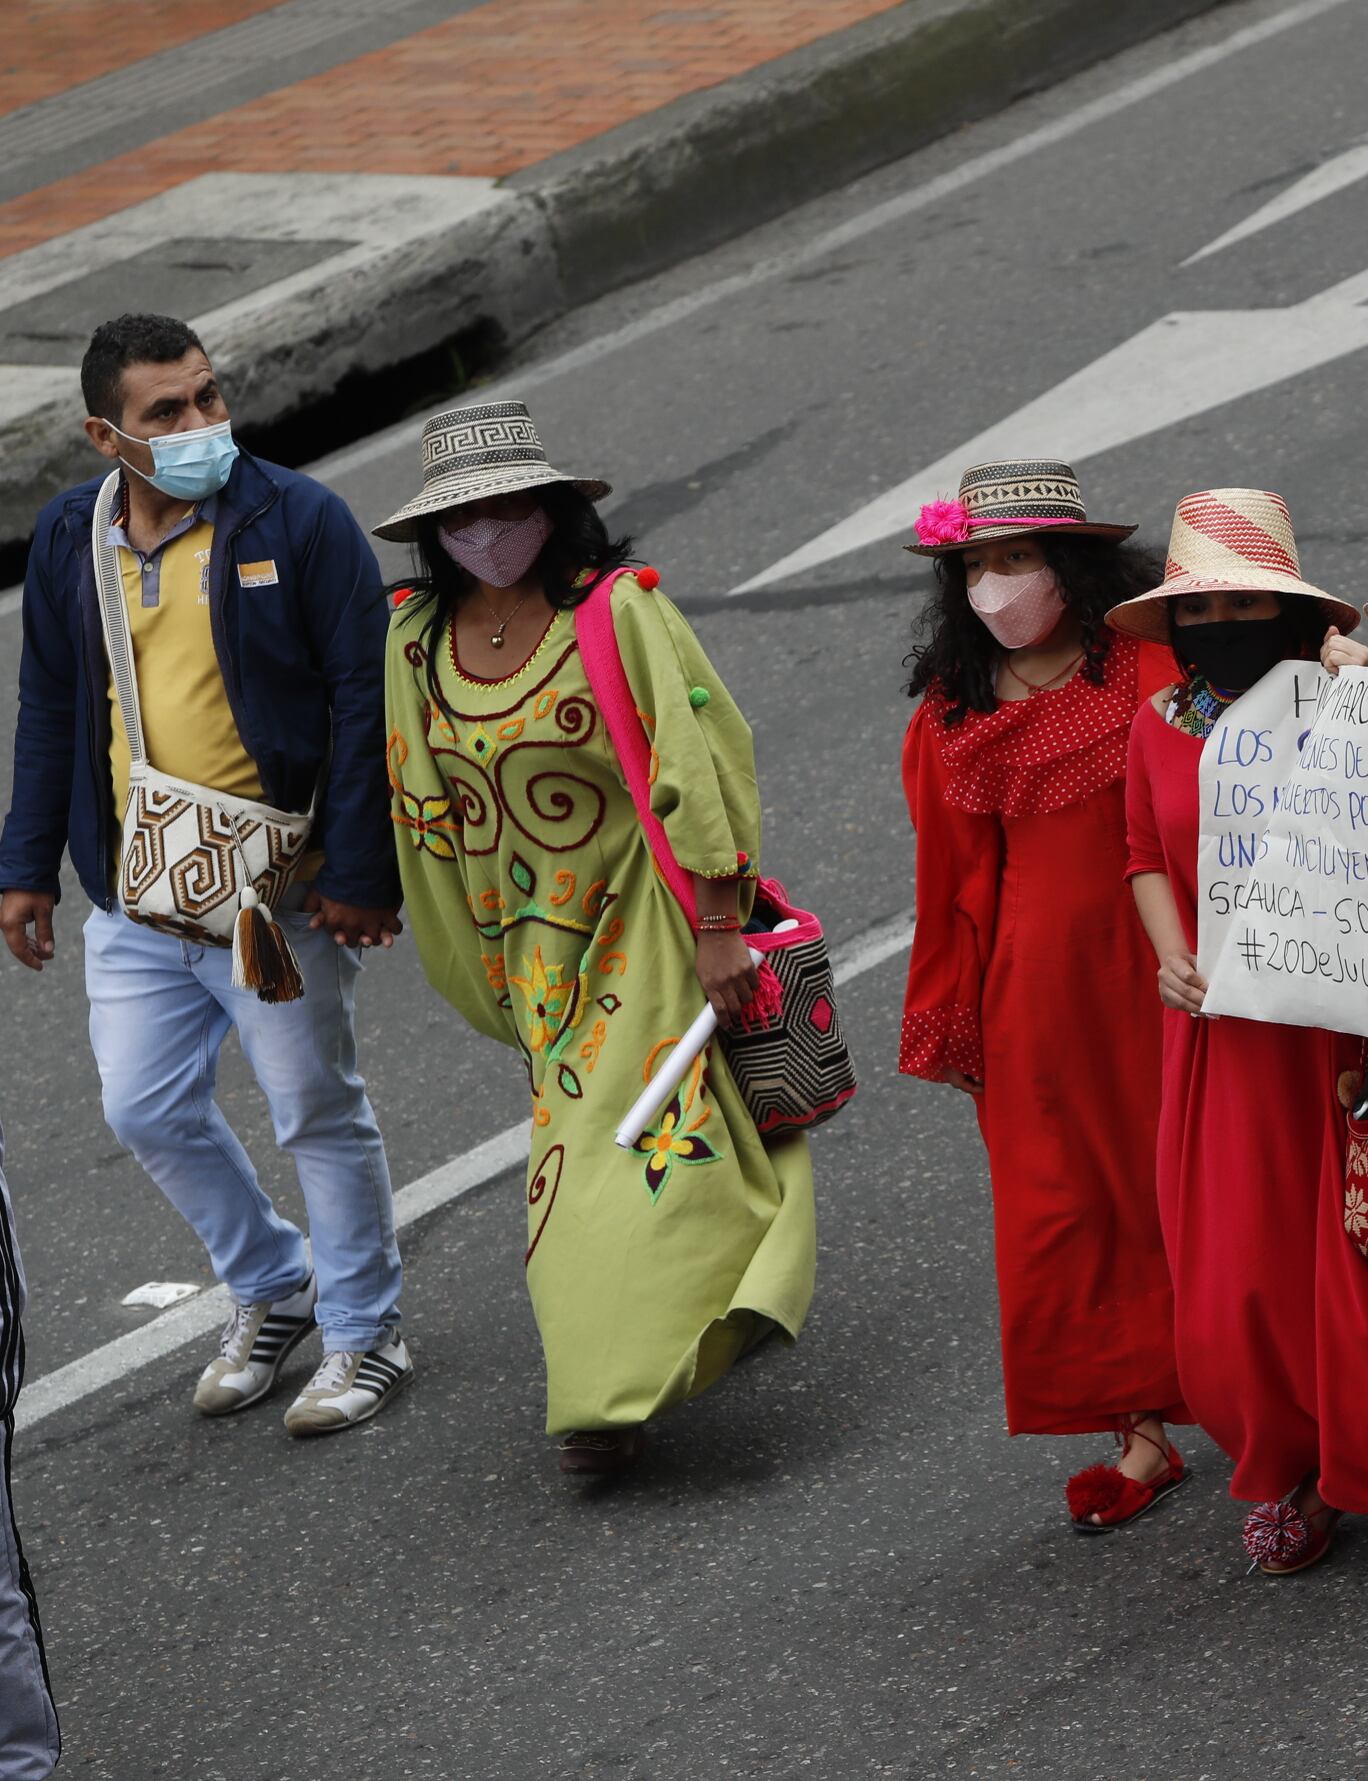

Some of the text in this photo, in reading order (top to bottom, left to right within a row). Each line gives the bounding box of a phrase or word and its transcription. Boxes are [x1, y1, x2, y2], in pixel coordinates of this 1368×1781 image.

[1217, 726, 1273, 767] LOS
[1344, 740, 1368, 780] DE
[1213, 780, 1265, 818] LOS
